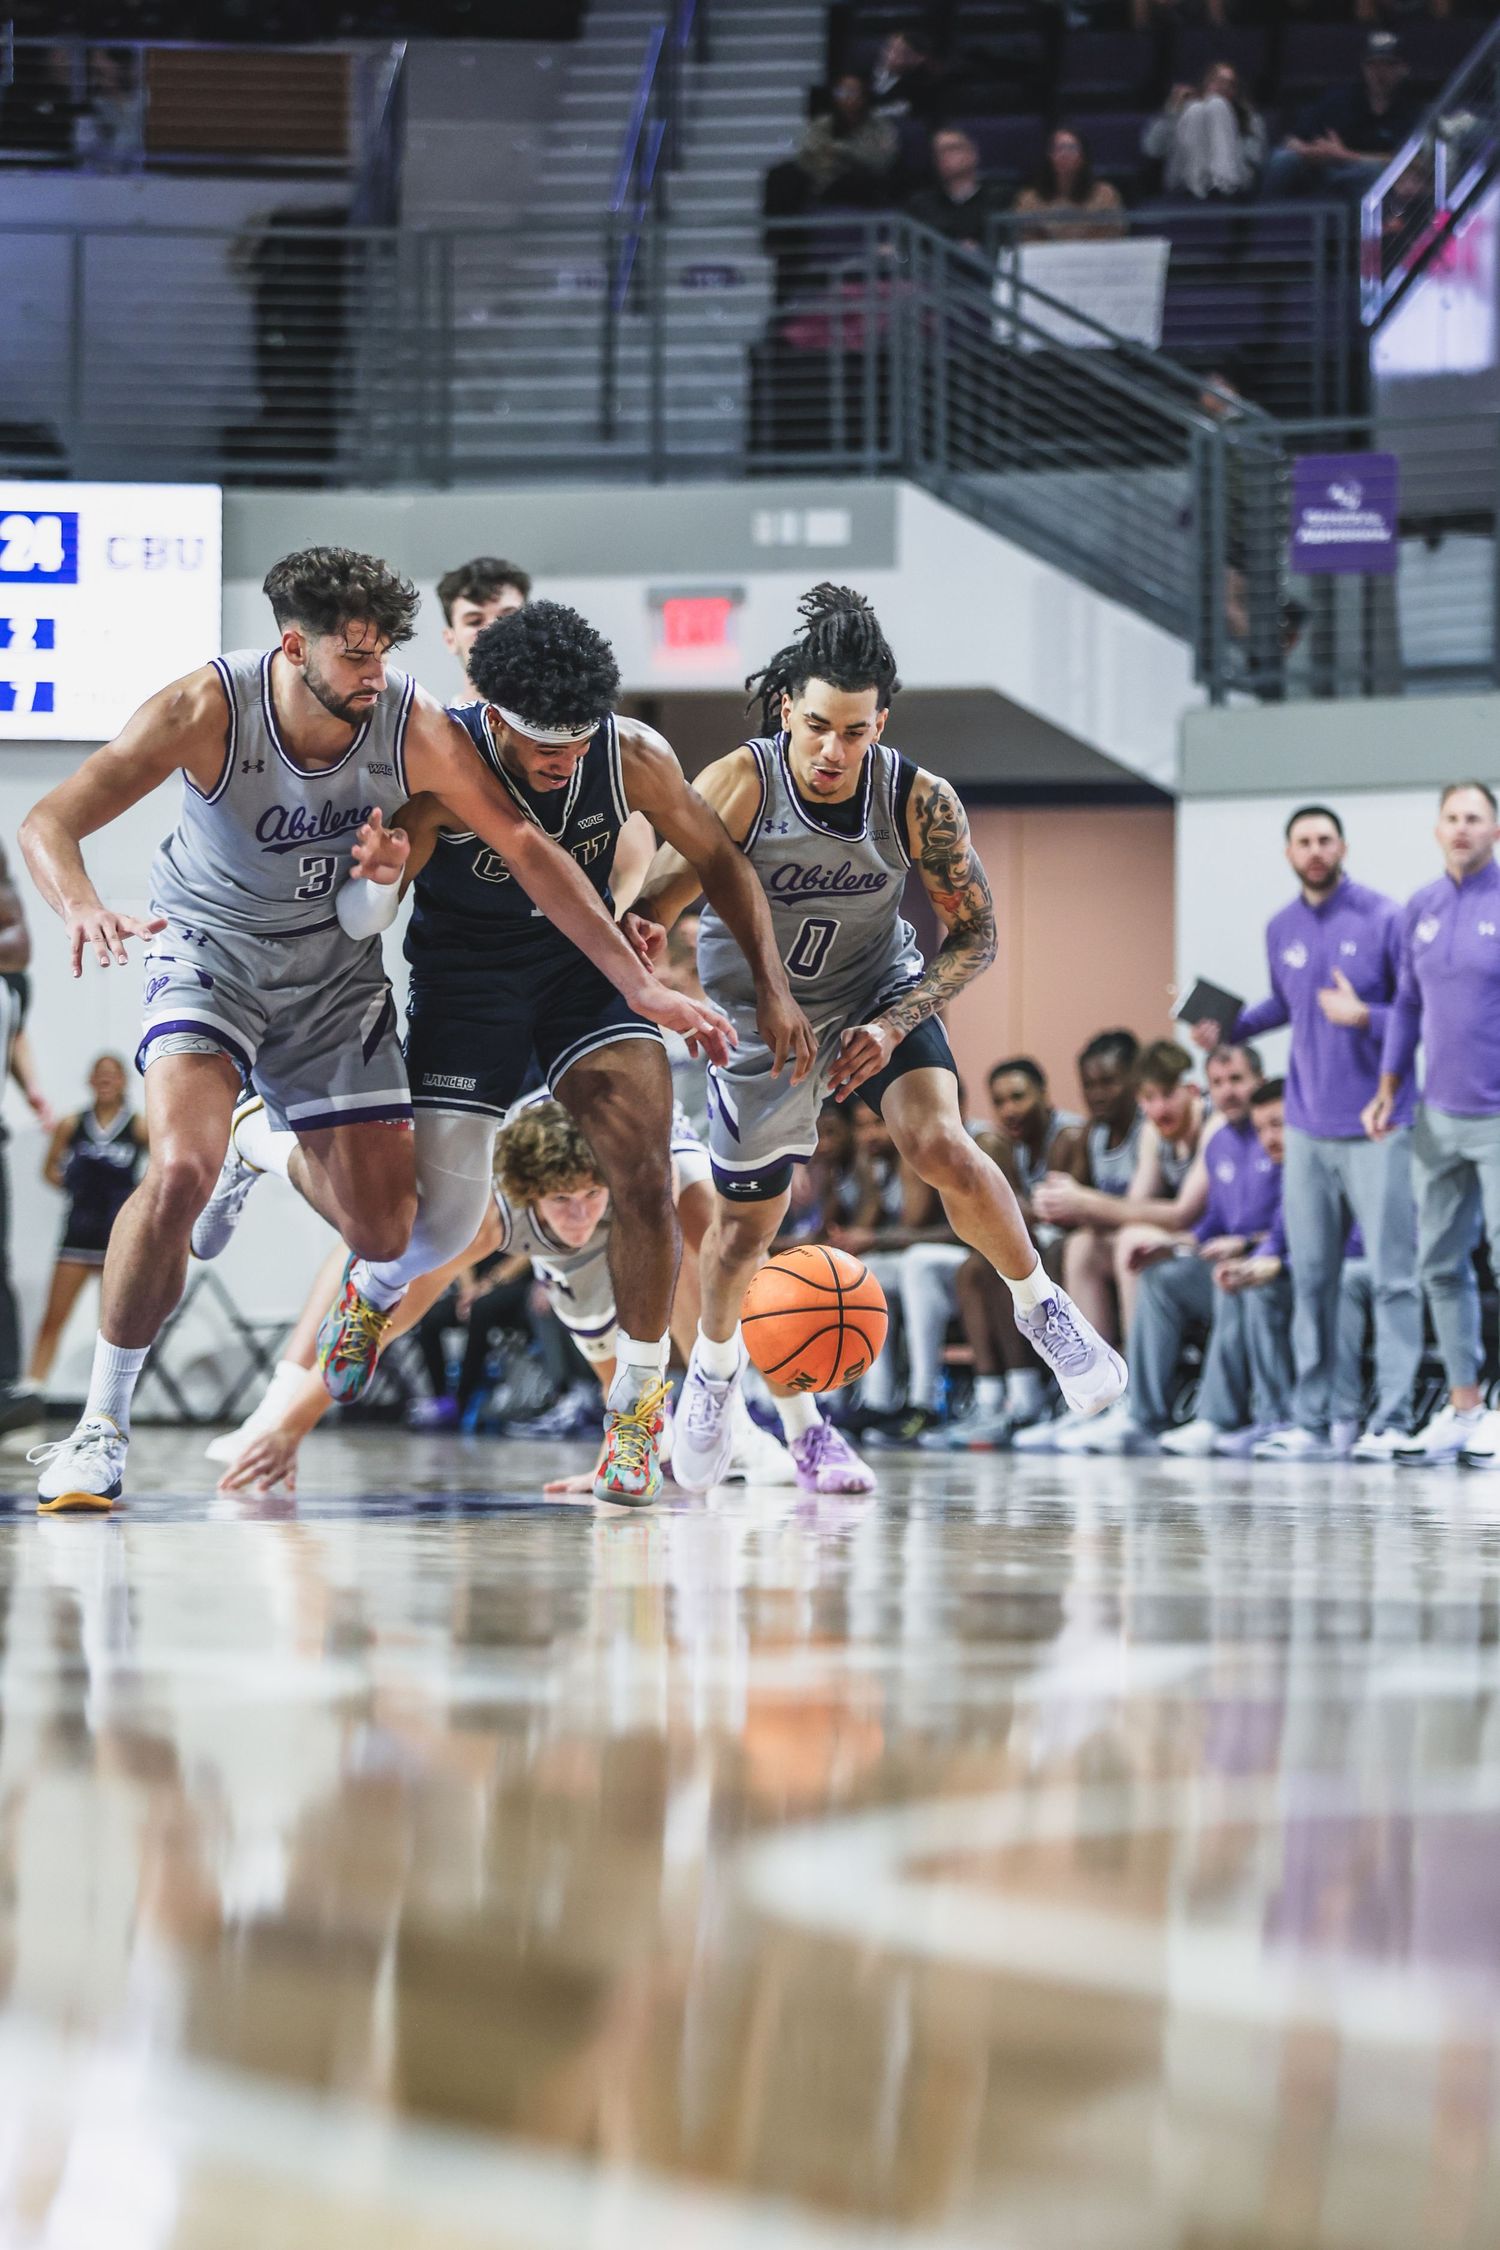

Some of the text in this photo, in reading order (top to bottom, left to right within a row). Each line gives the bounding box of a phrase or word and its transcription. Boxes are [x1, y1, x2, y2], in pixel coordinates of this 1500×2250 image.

[0, 514, 64, 572] 24
[106, 536, 204, 570] CBU
[368, 762, 393, 776] WAC
[256, 800, 373, 843] Abilene
[577, 813, 605, 829] WAC
[294, 857, 338, 900] 3
[770, 861, 888, 891] Abilene
[784, 917, 842, 980] 0
[423, 1073, 477, 1091] LANCERS
